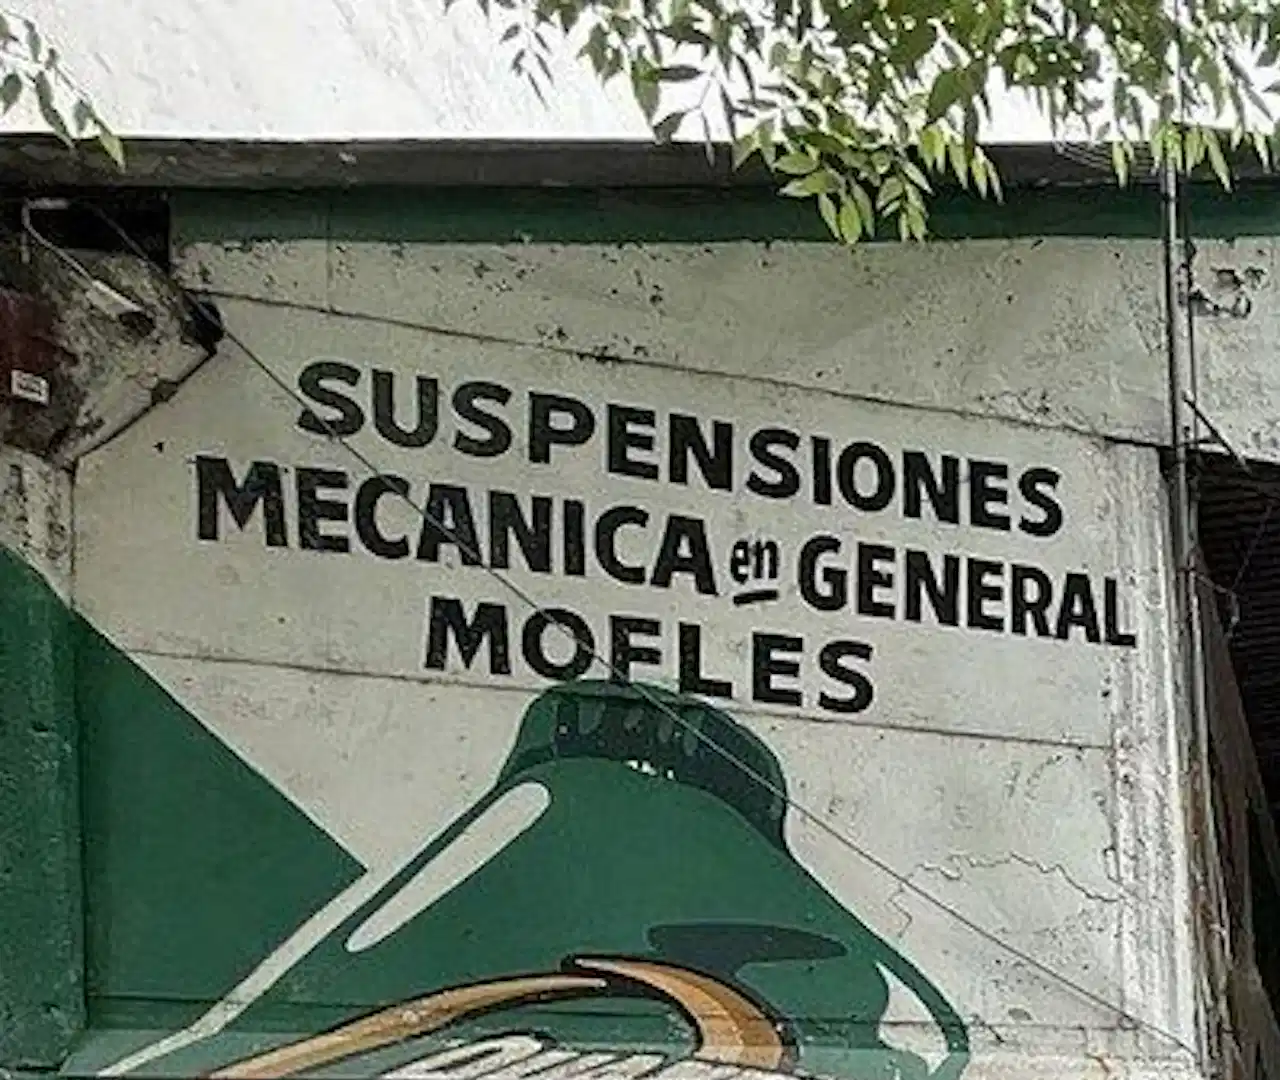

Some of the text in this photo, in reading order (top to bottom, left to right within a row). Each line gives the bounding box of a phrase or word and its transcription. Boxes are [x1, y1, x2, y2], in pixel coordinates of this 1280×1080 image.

[296, 360, 1063, 538] SUSPENSIONES
[197, 456, 1137, 648] MECANICA en GENERAL
[423, 596, 874, 713] MOFLES
